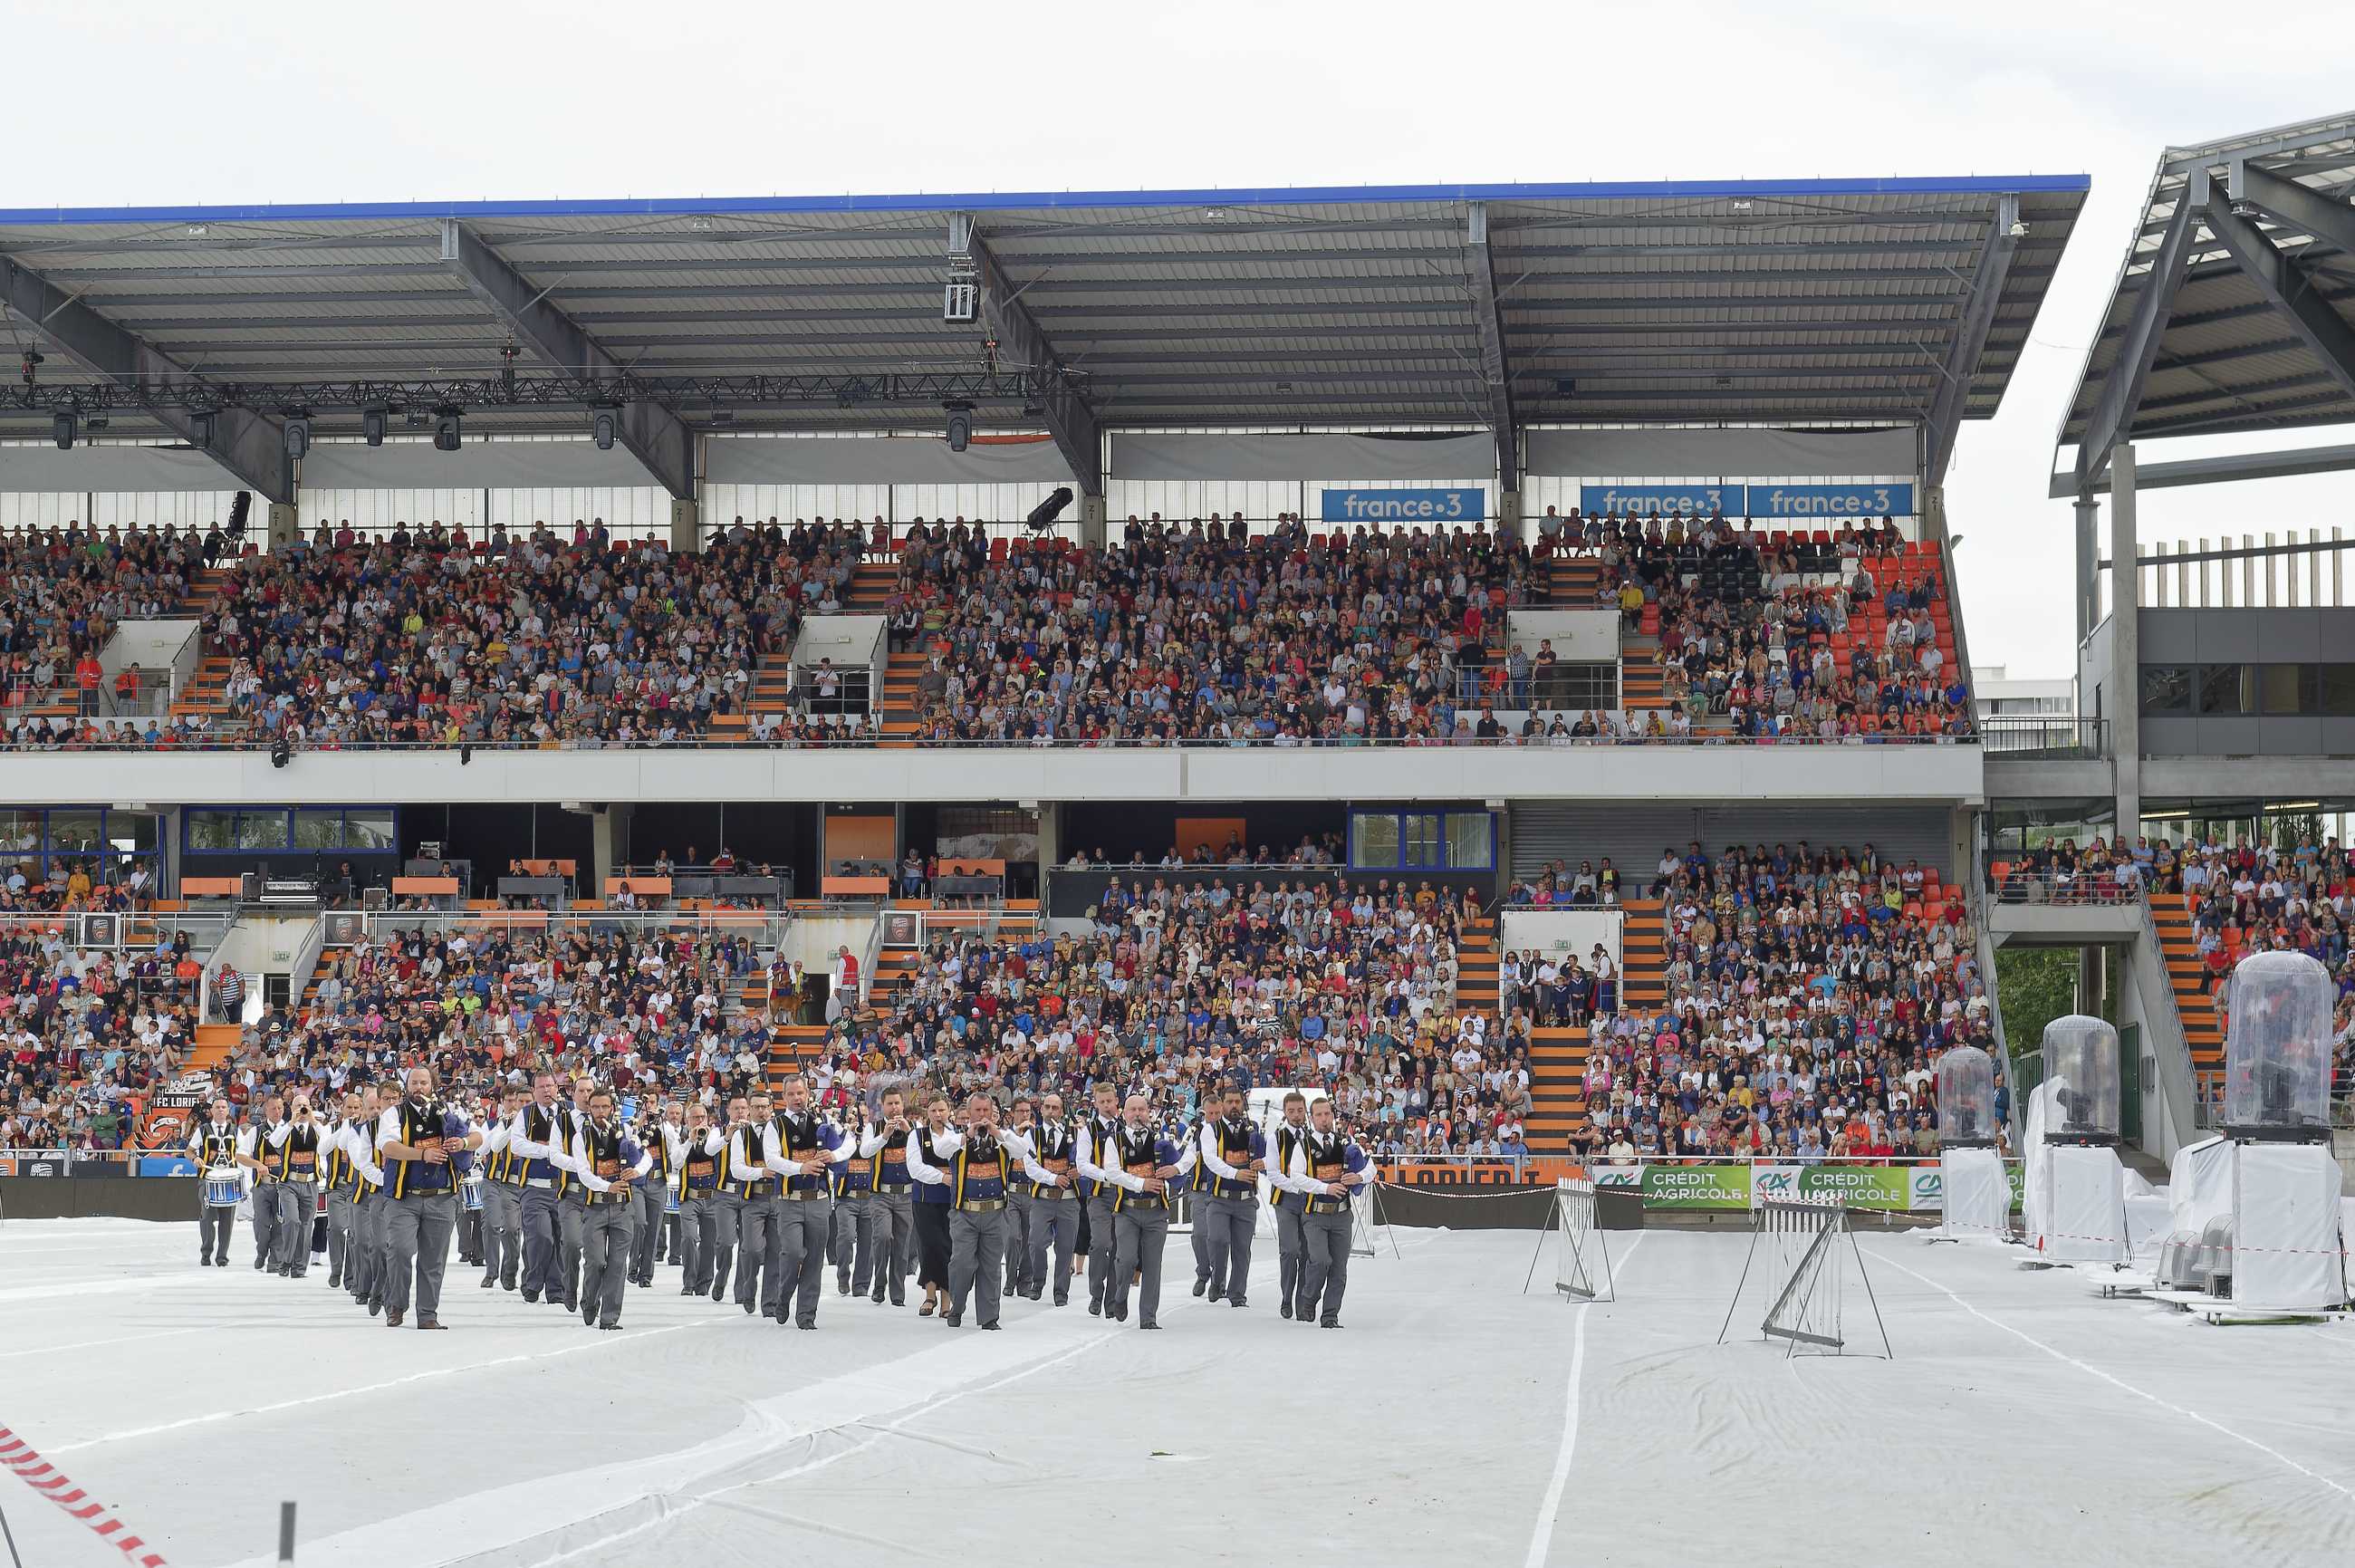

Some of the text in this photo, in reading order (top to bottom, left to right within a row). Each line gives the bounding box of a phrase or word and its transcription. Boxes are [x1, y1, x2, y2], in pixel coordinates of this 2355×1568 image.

[157, 1097, 199, 1107] FC LORIE
[1652, 1171, 1716, 1185] CRÉDIT
[1811, 1172, 1875, 1186] CRÉDIT
[1653, 1188, 1742, 1200] AGRICOLE
